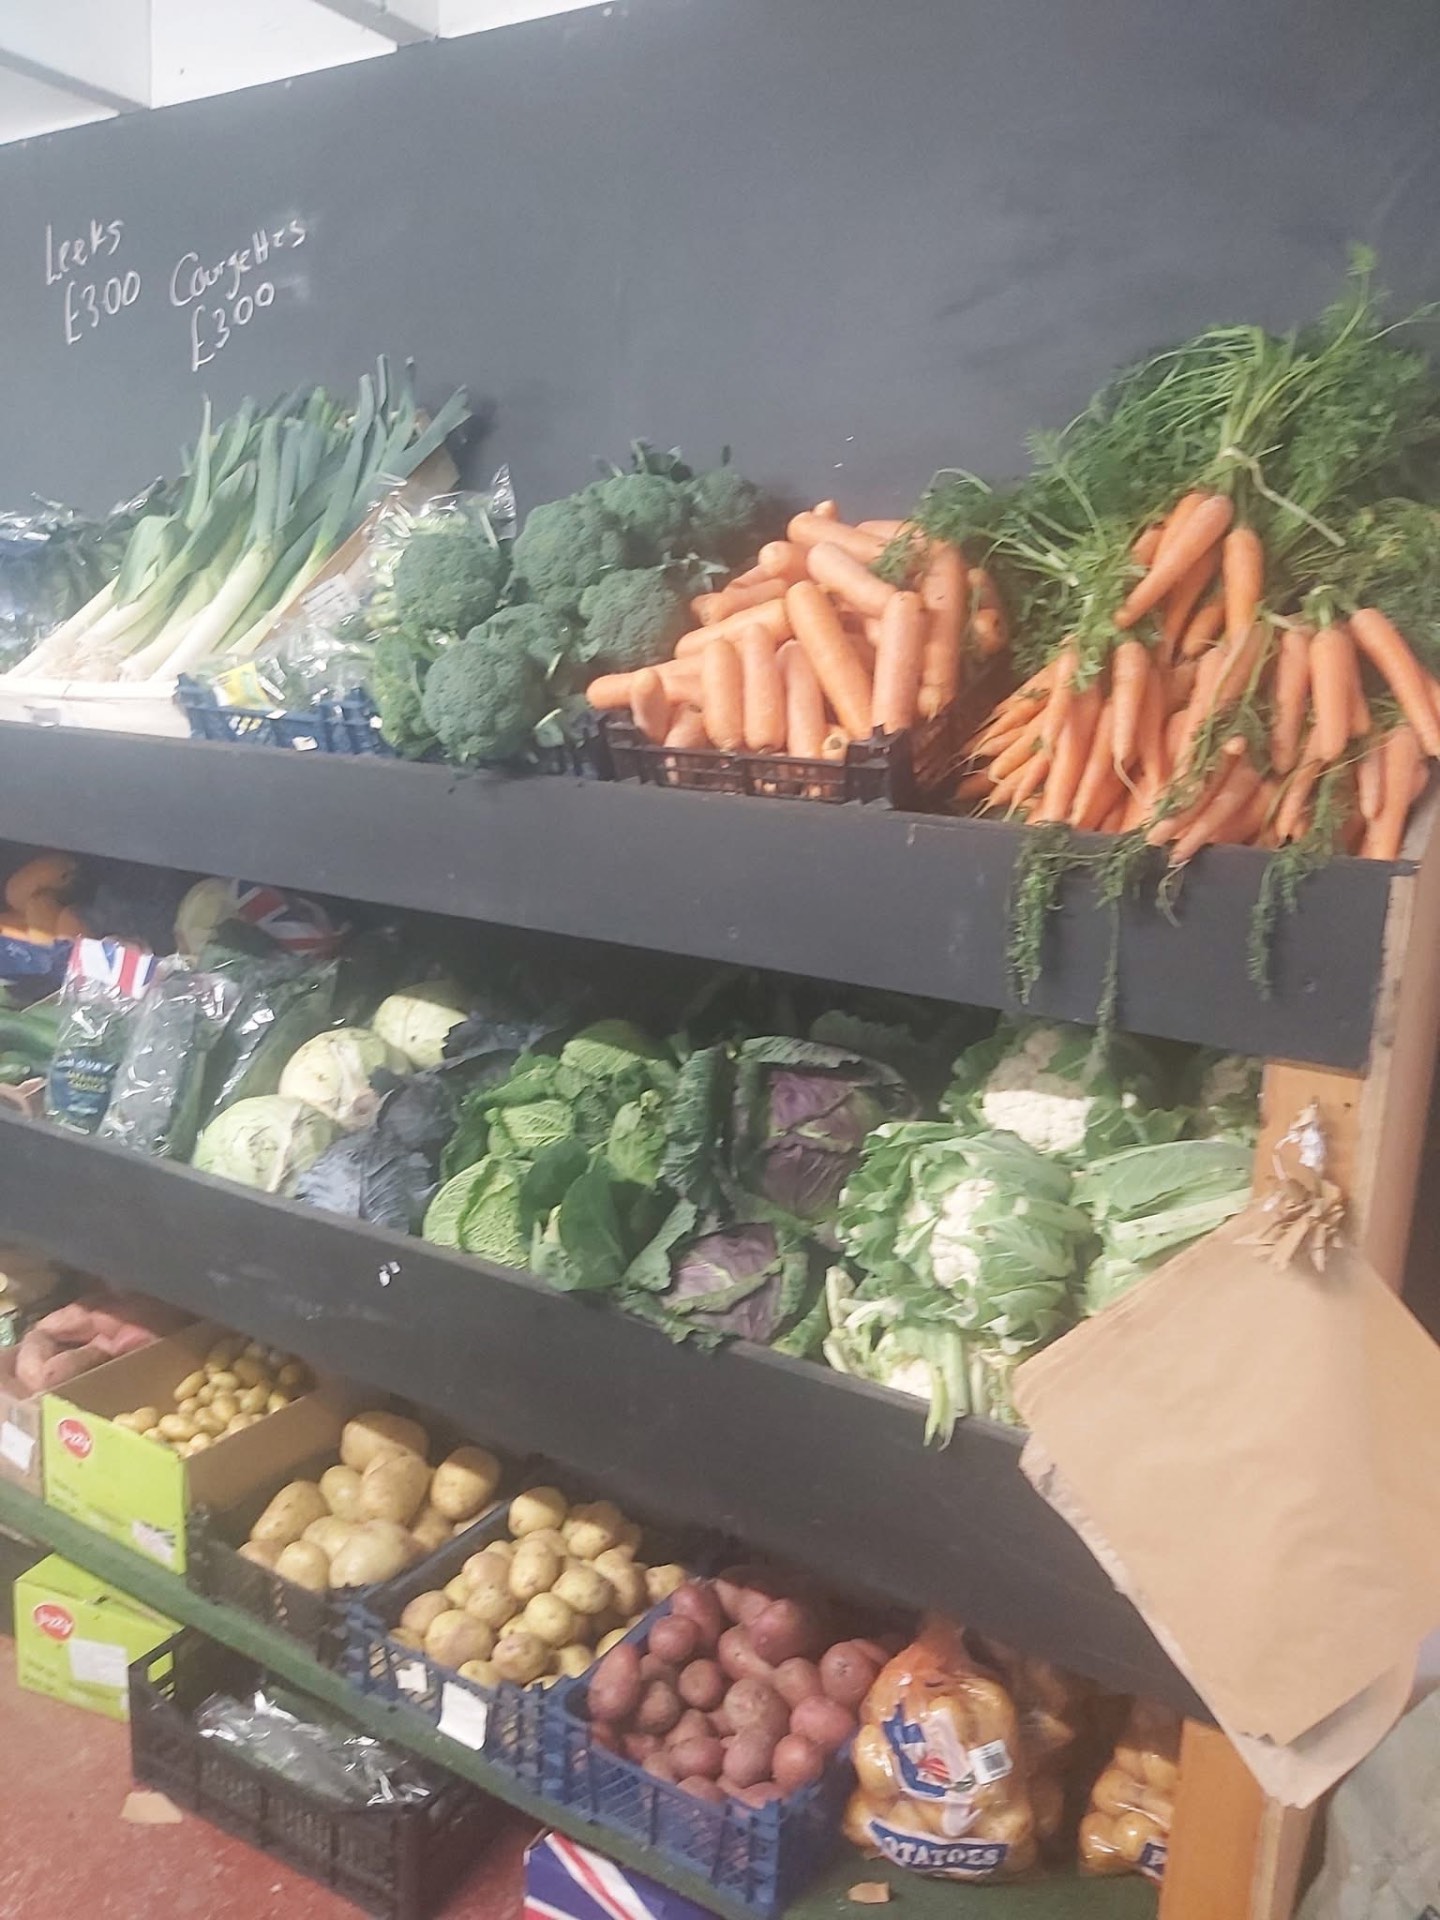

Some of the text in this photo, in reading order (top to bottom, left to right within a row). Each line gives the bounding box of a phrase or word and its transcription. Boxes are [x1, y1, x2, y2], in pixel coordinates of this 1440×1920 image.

[46, 219, 124, 285] Leeks
[65, 271, 141, 345] £300
[191, 281, 275, 372] £300
[879, 1836, 1001, 1867] OTATOES
